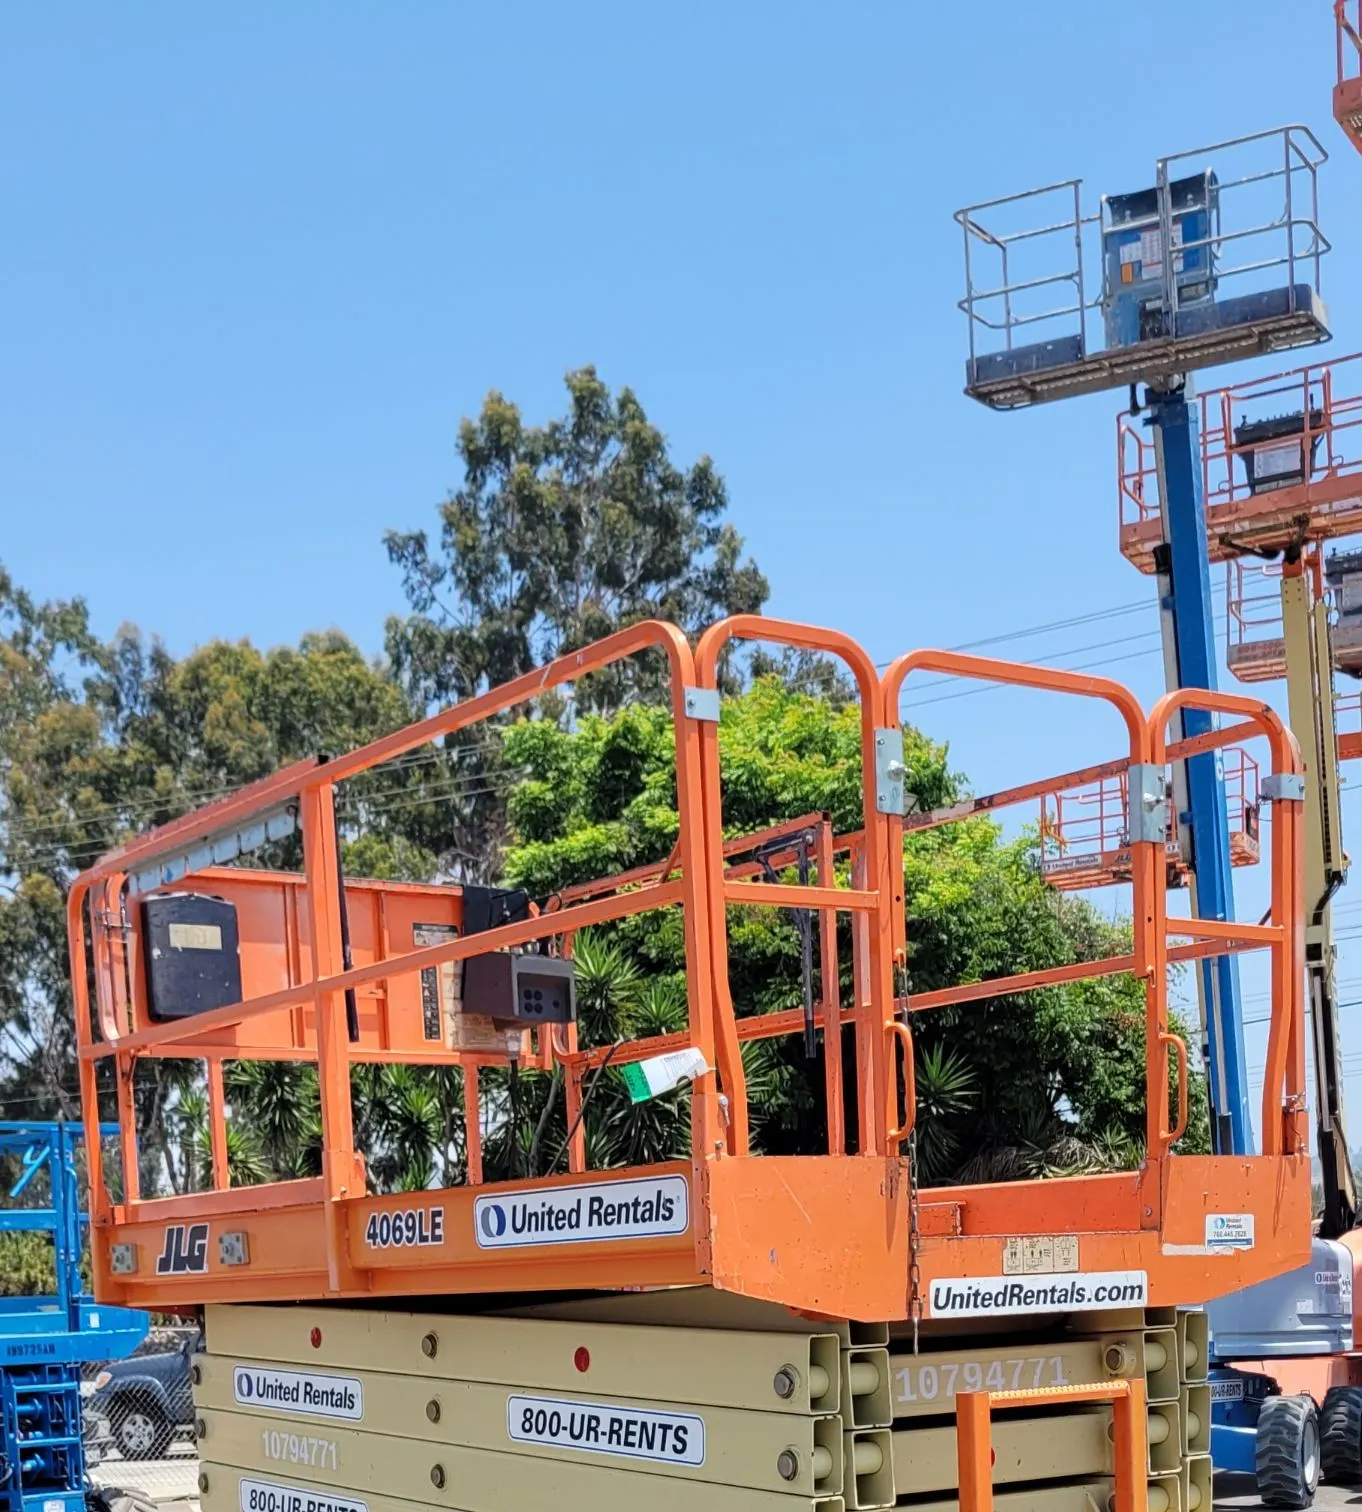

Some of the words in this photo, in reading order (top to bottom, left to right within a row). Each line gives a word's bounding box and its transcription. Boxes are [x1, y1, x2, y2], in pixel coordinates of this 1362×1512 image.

[366, 1207, 443, 1248] 4069LE
[511, 1198, 581, 1235] United
[588, 1189, 675, 1227] Rentals
[157, 1223, 209, 1275] JLG
[934, 1281, 1144, 1311] UnitedRentals.com
[256, 1376, 300, 1403] United
[303, 1382, 355, 1410] Rentals
[895, 1355, 1069, 1402] 10794771
[1211, 1383, 1242, 1398] 00-UR-RENTS
[262, 1430, 338, 1470] 10794771
[521, 1407, 689, 1455] 800-UR-RENTS
